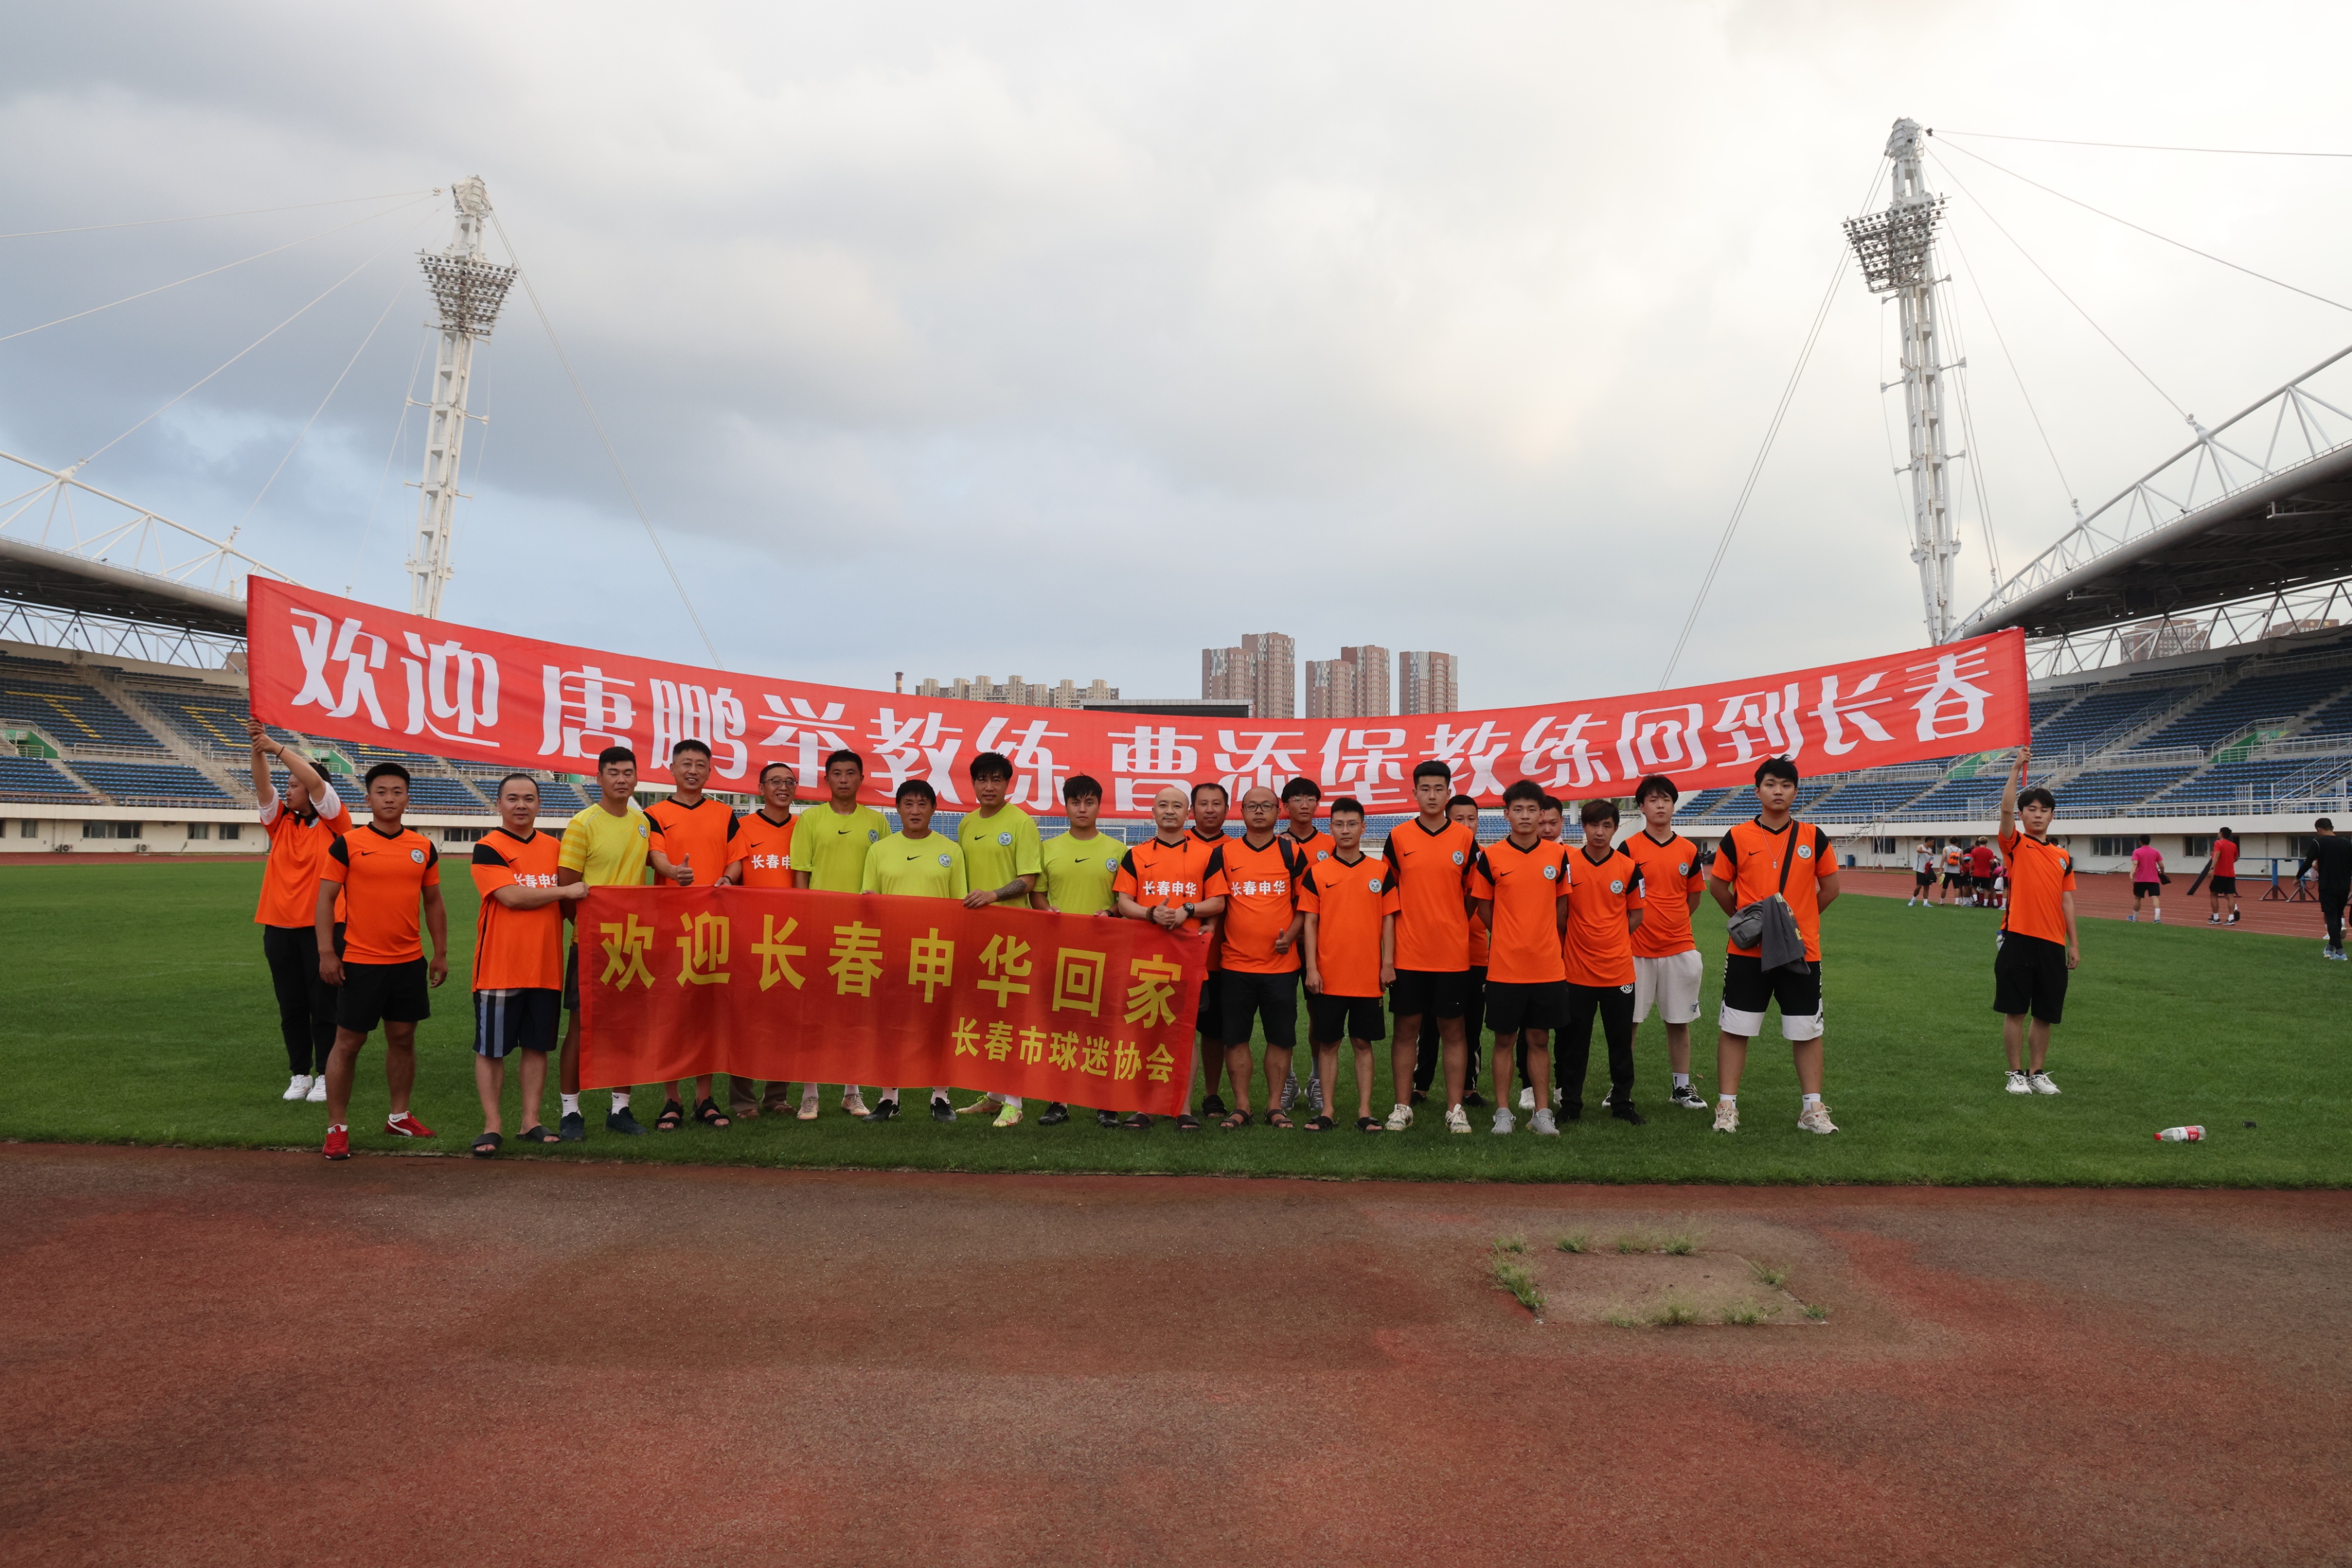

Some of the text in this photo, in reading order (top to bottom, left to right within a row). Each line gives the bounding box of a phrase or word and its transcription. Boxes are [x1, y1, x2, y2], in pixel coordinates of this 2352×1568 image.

[290, 607, 500, 748] 欢迎
[537, 664, 1070, 811] 唐鹏举教练
[1143, 880, 1197, 897] 长春申华
[1231, 880, 1286, 896] 长春申华
[599, 911, 1182, 1028] 欢迎长春申华回家
[951, 1016, 1176, 1083] 长春市球迷协会
